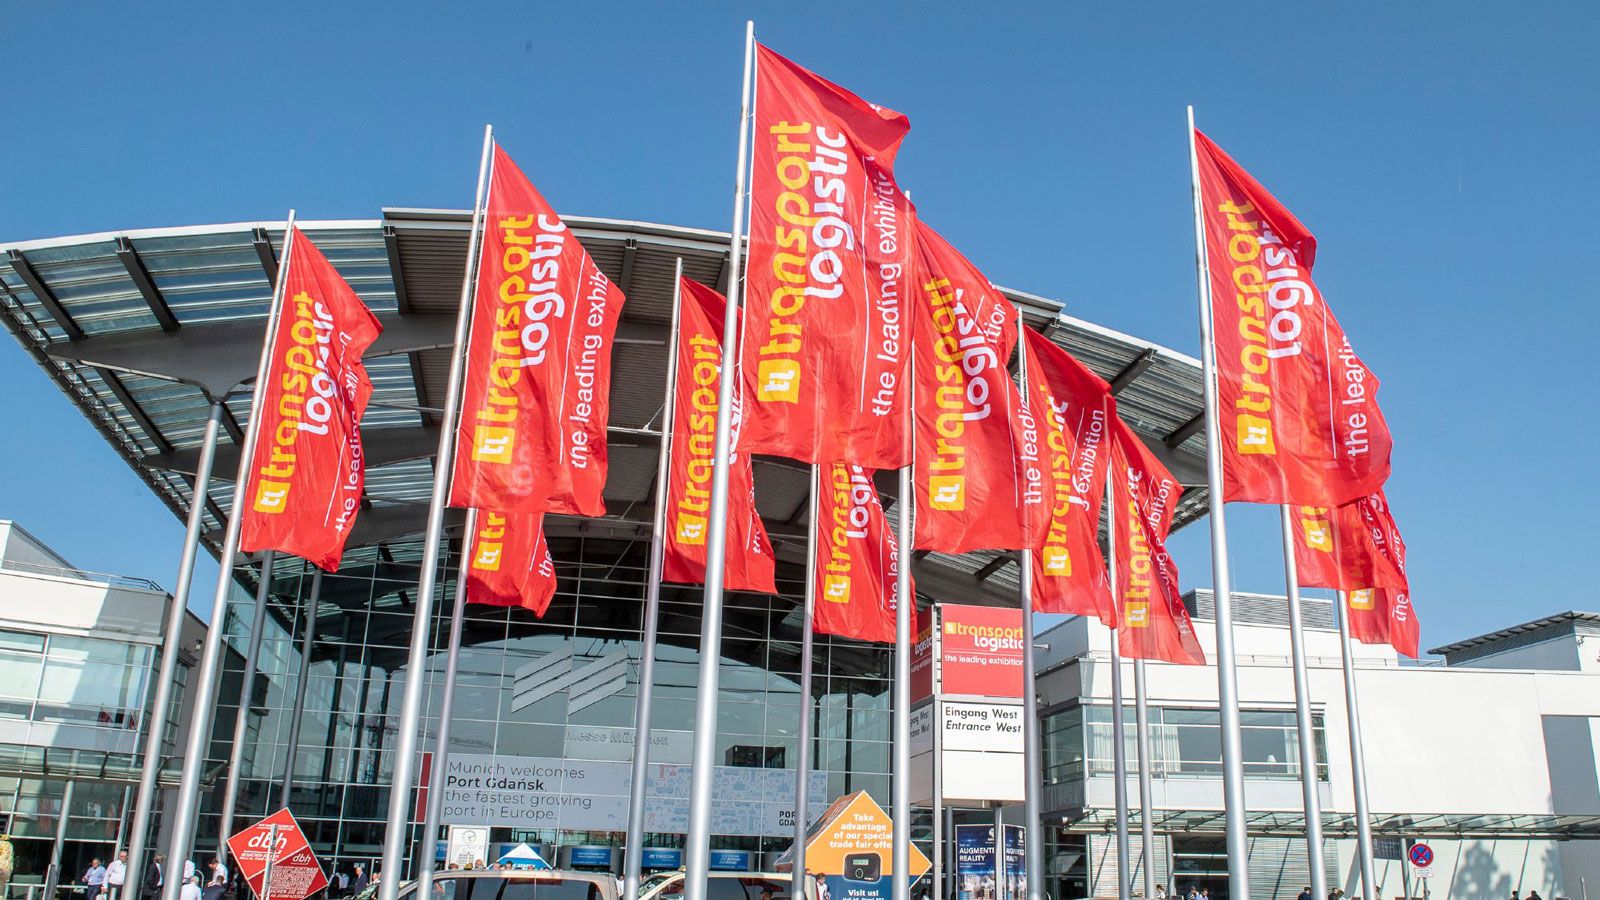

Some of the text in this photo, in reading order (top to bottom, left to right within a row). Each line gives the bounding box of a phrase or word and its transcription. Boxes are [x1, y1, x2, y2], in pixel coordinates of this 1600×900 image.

[804, 126, 854, 299] logistic
[760, 120, 812, 356] transport
[520, 212, 567, 367] logistic
[1219, 199, 1271, 413] transport
[476, 213, 534, 422] transport
[877, 264, 902, 368] leading
[260, 290, 315, 479] transport
[570, 334, 603, 429] leading
[924, 277, 965, 473] transport
[872, 373, 896, 417] the
[678, 333, 719, 513] transport
[1348, 414, 1369, 458] the
[569, 433, 588, 469] the
[1077, 409, 1104, 495] exhibition
[1024, 472, 1042, 506] the
[335, 497, 356, 533] the
[957, 622, 1024, 639] transport
[944, 654, 957, 663] the
[959, 655, 987, 666] leading
[945, 706, 1018, 720] Eingang West
[945, 720, 1022, 733] Entrance West
[447, 775, 548, 792] Port Gdańsk,
[449, 761, 586, 779] Munich welcomes
[443, 805, 558, 821] port in Europe.
[445, 790, 592, 810] the fastest growing
[840, 822, 887, 833] advantage
[853, 813, 874, 822] Take
[247, 831, 288, 850] dbh
[829, 840, 892, 849] trade fair offe
[833, 831, 844, 840] of
[863, 831, 893, 842] special
[292, 853, 312, 863] dbh
[847, 889, 879, 897] Visit us!
